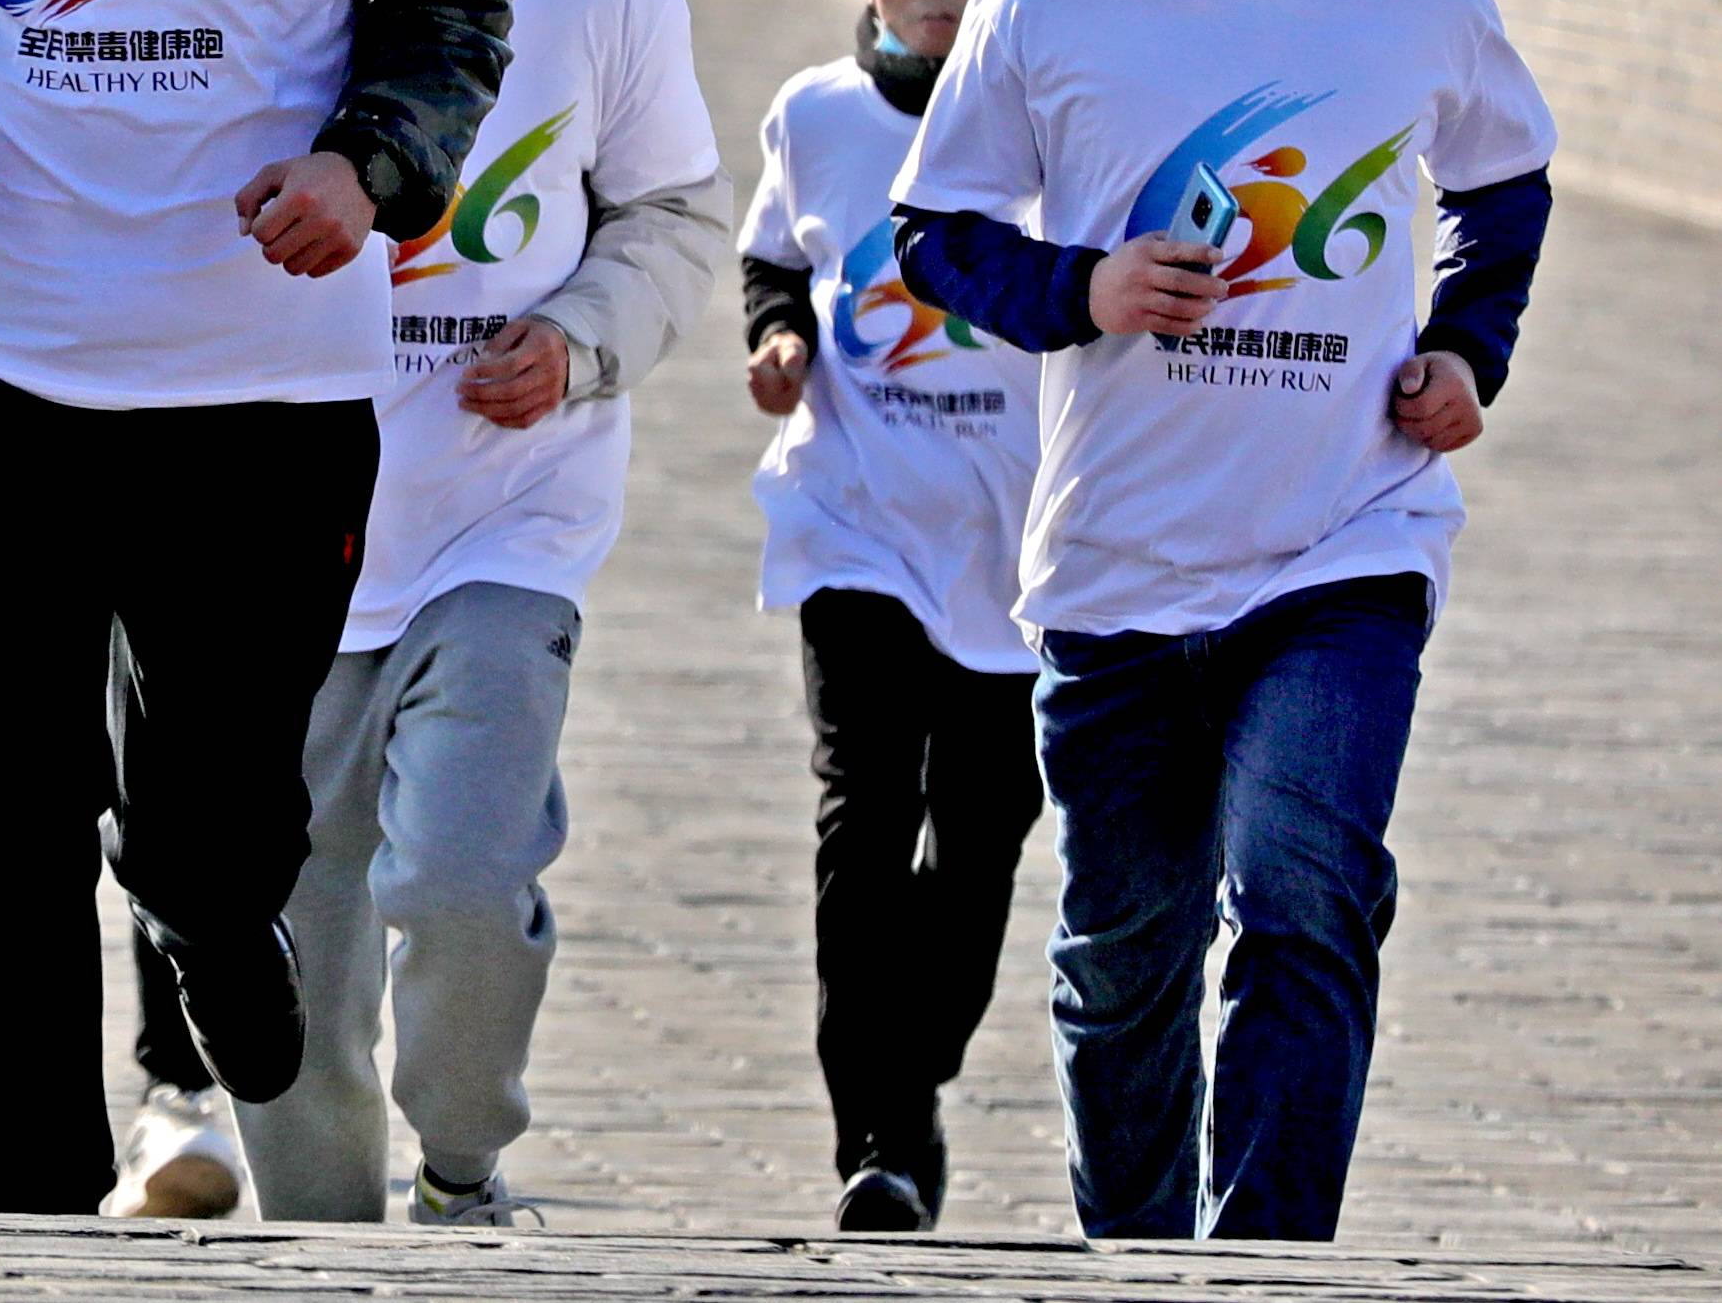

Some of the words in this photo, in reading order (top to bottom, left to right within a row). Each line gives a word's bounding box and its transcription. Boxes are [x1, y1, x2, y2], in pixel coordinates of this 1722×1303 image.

[26, 67, 144, 93] HEALTHY
[153, 69, 210, 91] RUN
[1154, 326, 1350, 364] 民禁毒健康跑
[1281, 369, 1332, 393] RUN
